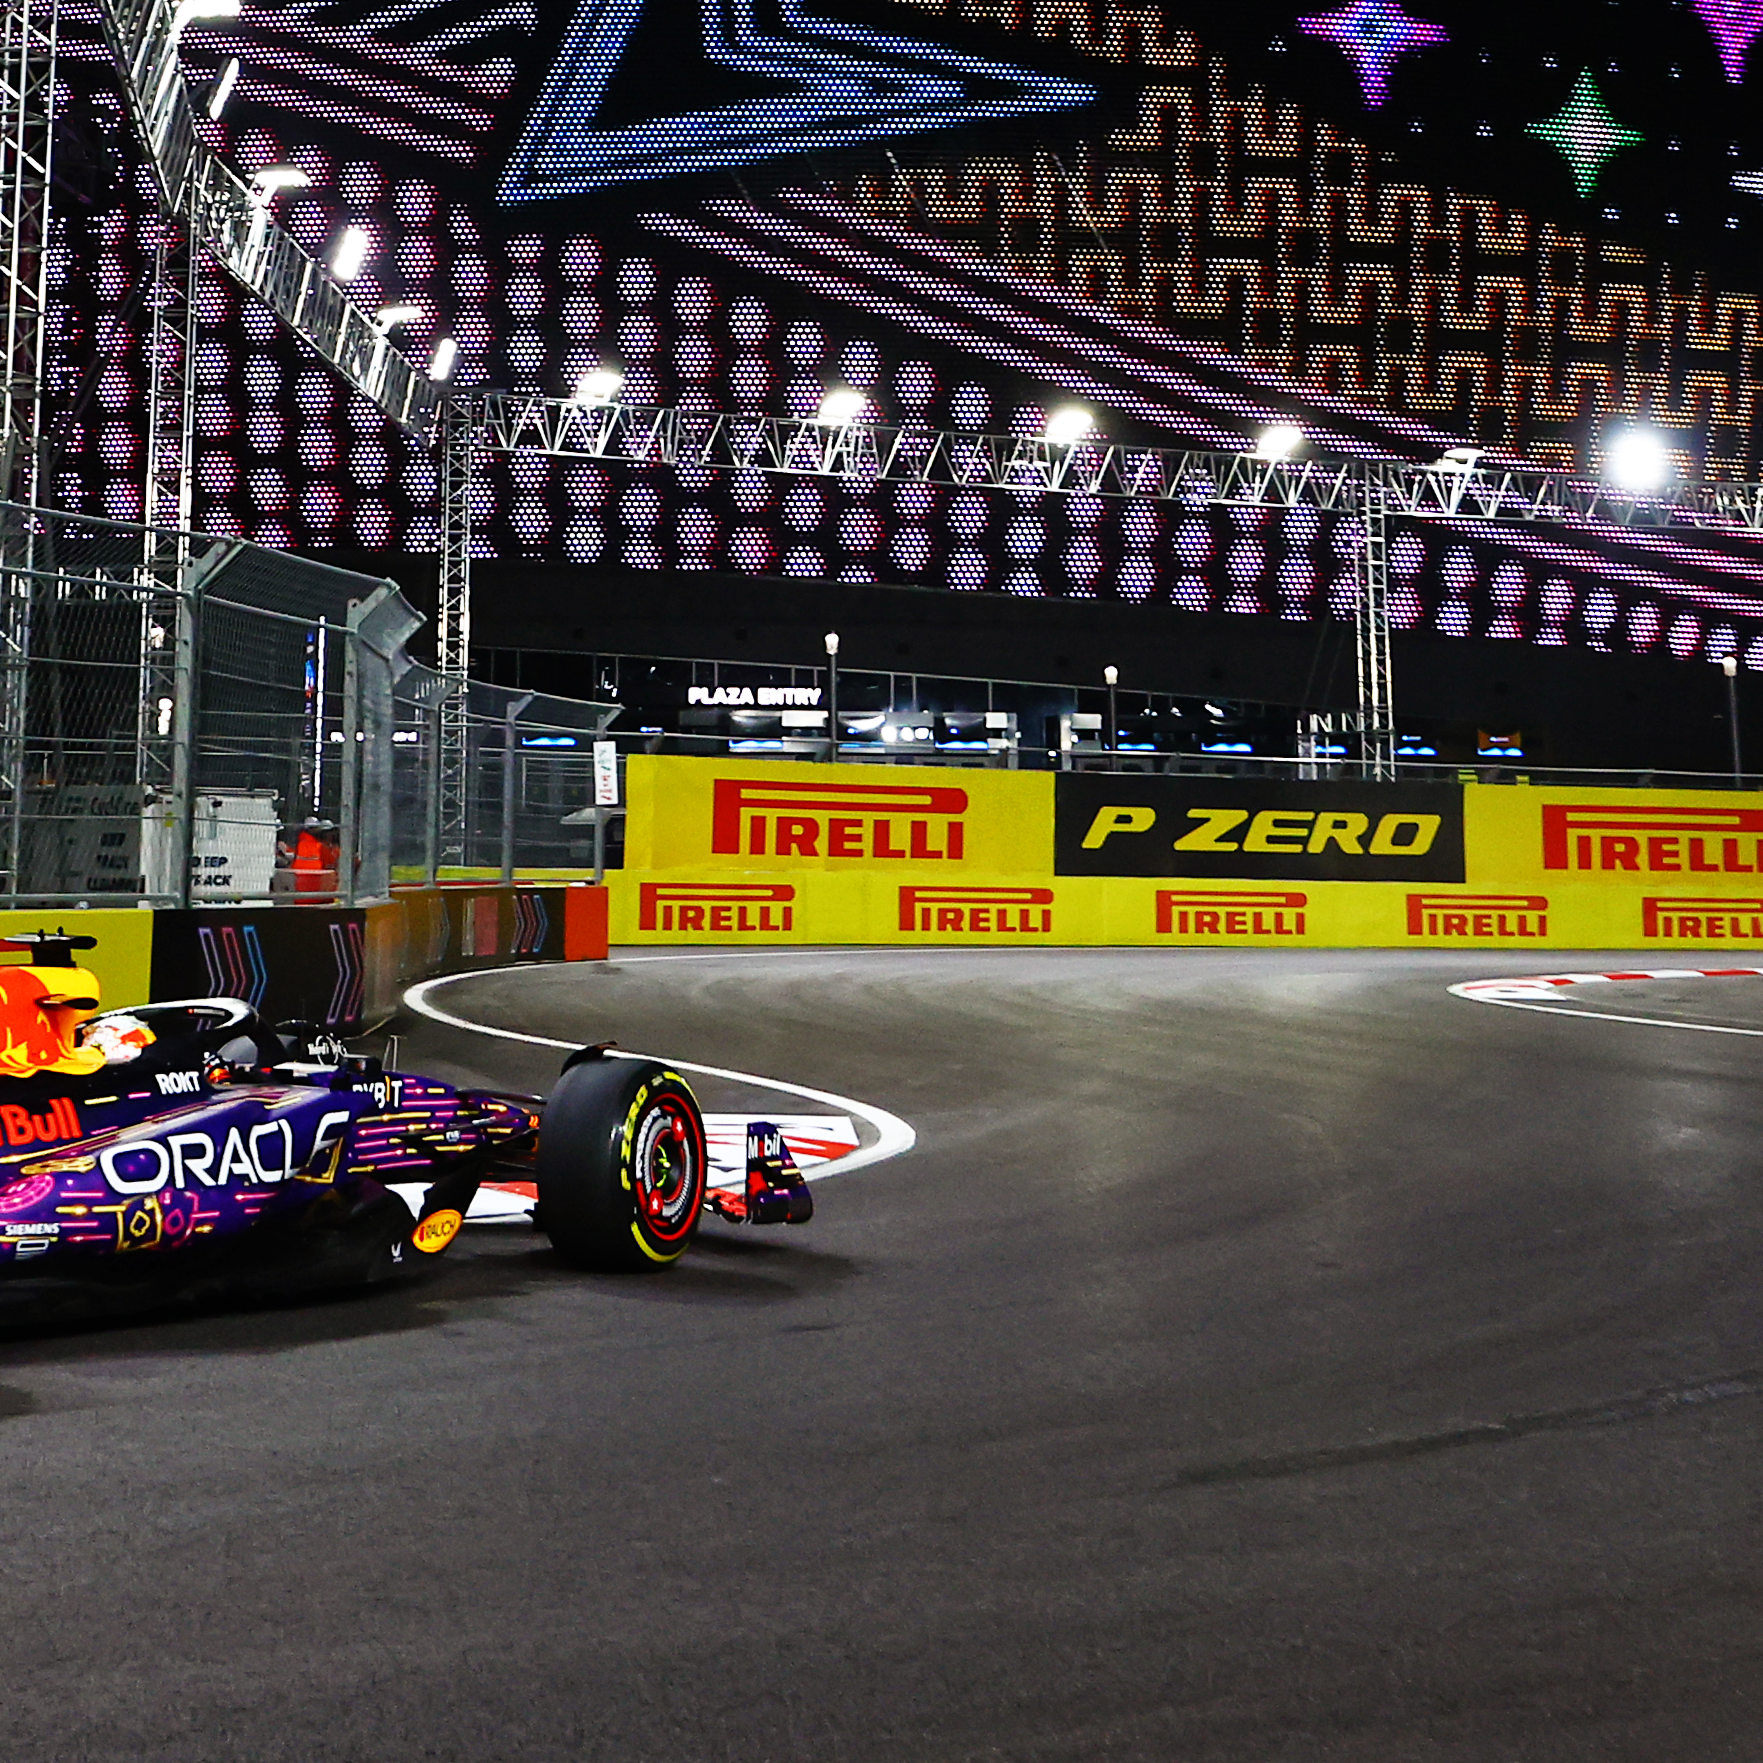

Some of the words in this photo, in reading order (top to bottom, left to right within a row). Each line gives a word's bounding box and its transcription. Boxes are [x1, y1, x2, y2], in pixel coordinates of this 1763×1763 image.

[688, 686, 755, 705] PLAZA
[757, 687, 823, 705] ENTRY
[712, 779, 968, 860] PIRELLI
[1082, 807, 1155, 849] P
[1174, 809, 1441, 855] ZERO
[639, 883, 795, 932] PIRELLI
[899, 886, 1054, 933] PIRELLI
[1156, 890, 1307, 935] PIRELLI
[1407, 894, 1549, 937] PIRELLI
[155, 1071, 200, 1095] ROKT
[100, 1110, 350, 1194] ORACLE
[5, 1223, 61, 1236] SIEMENS
